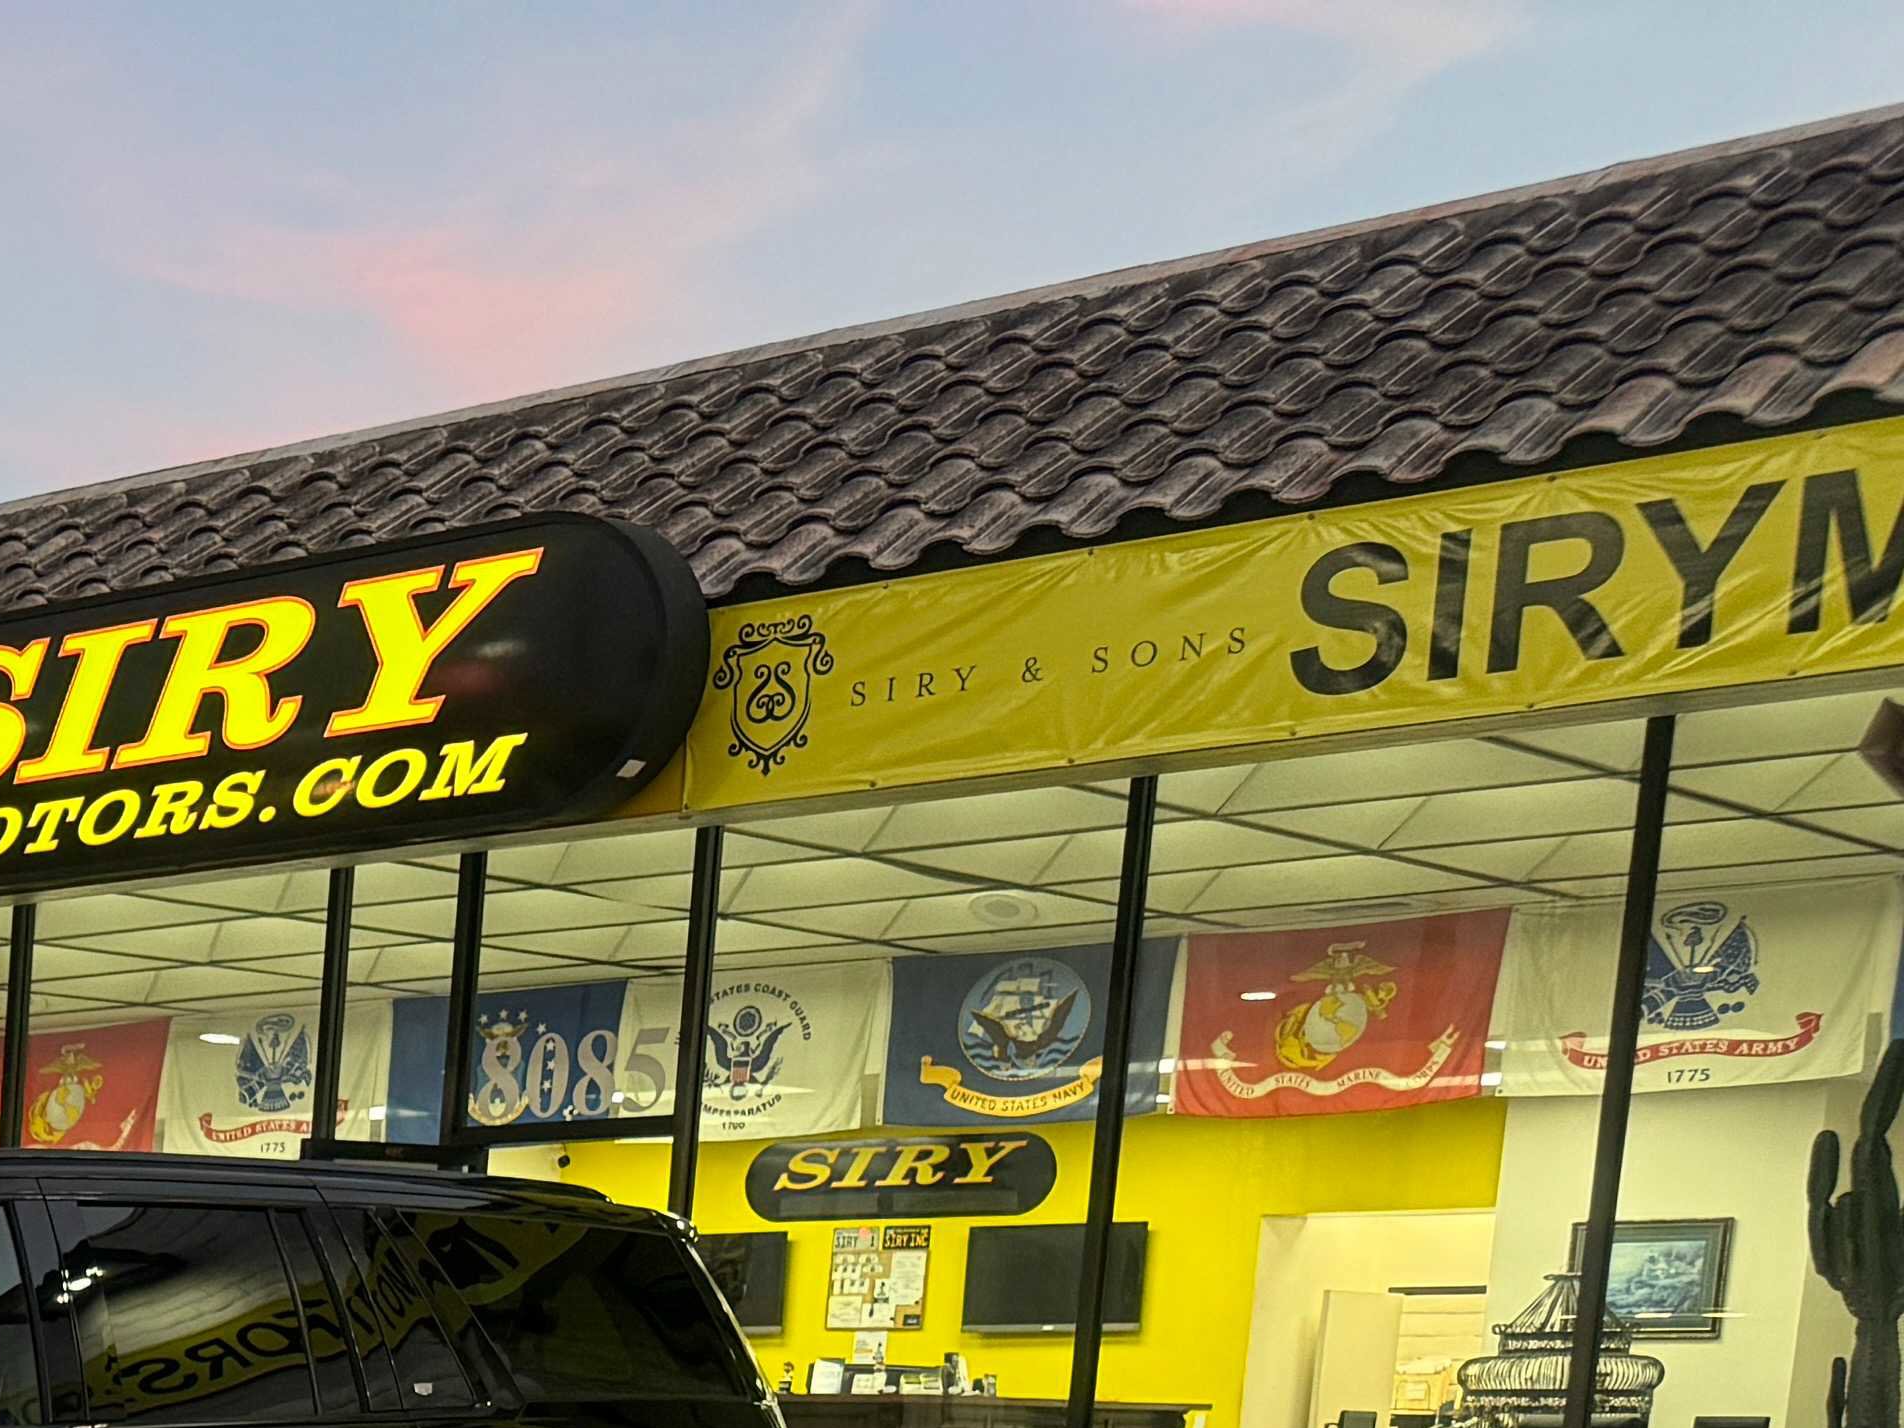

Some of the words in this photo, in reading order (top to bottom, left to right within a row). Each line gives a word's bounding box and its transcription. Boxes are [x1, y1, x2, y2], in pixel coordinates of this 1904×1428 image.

[849, 664, 977, 708] SIRY
[1021, 656, 1044, 684] &
[1091, 626, 1247, 674] SONS
[753, 983, 792, 1003] COAST
[790, 1000, 812, 1041] GUARD
[1658, 1040, 1729, 1056] STATES
[1734, 1039, 1799, 1055] ARMY
[479, 1026, 670, 1120] 8085
[1220, 1068, 1255, 1097] UNITED
[1274, 1074, 1311, 1090] STATES
[1336, 1067, 1382, 1088] MARINE
[1666, 1068, 1711, 1083] 1775
[951, 1088, 997, 1112] UNITED
[1001, 1096, 1048, 1112] STATES
[1052, 1081, 1086, 1103] NAVY
[212, 1125, 253, 1141] UNITED
[260, 1141, 286, 1153] 1775
[773, 1139, 1029, 1192] SIRY
